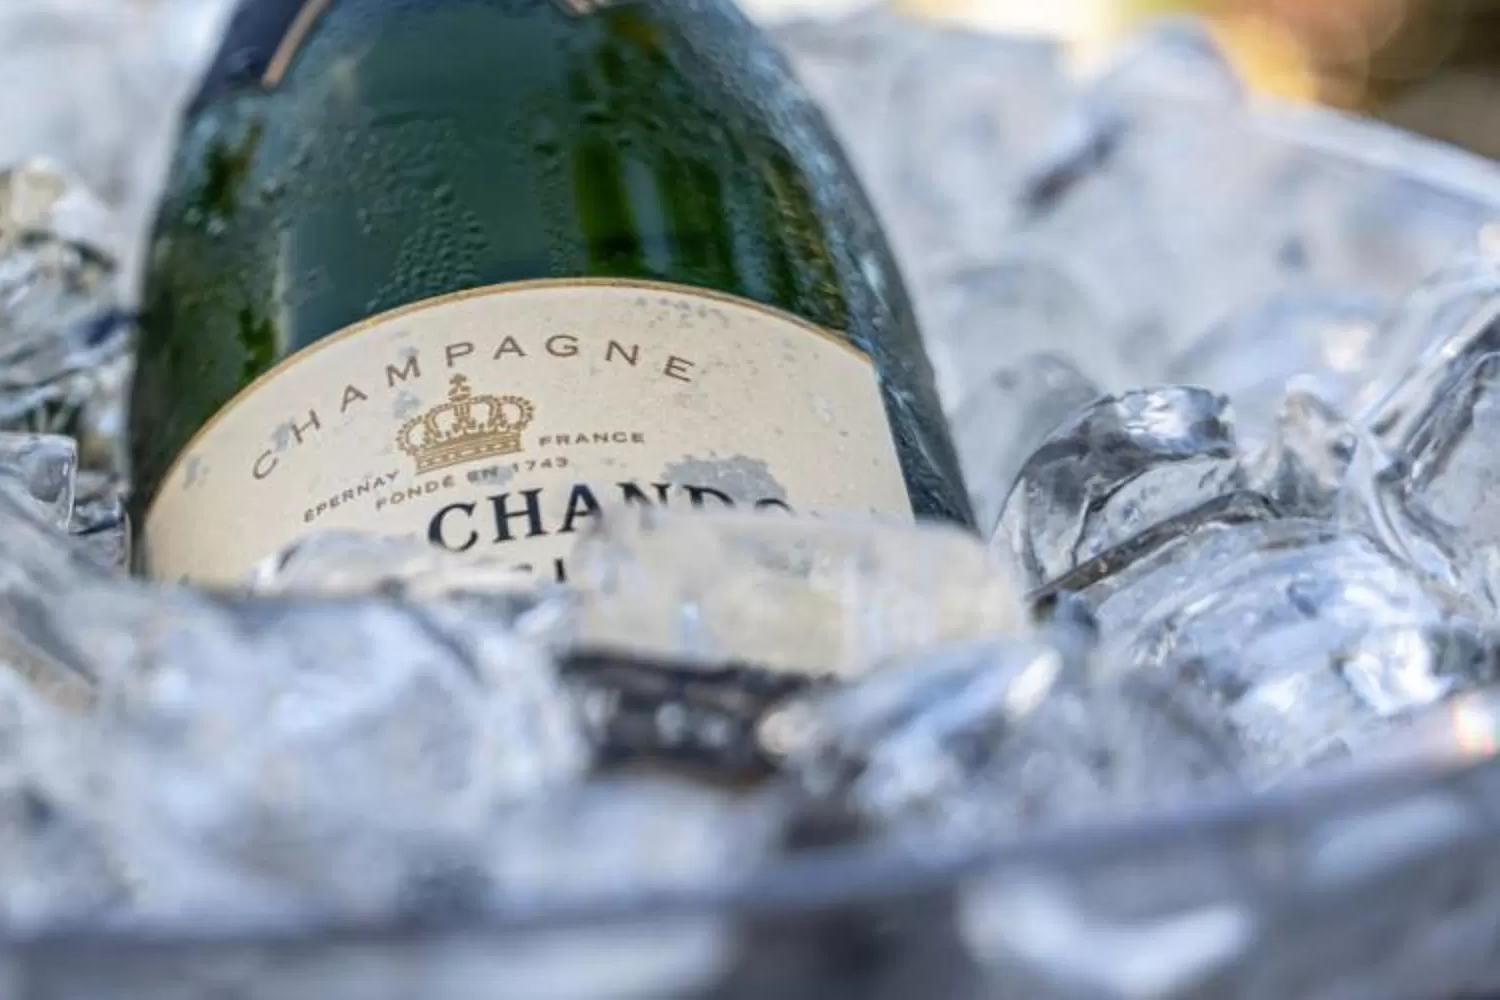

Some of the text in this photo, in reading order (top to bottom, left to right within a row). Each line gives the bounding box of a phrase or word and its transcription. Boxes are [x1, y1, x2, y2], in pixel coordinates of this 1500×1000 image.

[252, 334, 695, 480] CHAMPAGNE
[538, 431, 645, 447] FRANCE
[466, 464, 499, 483] EN
[511, 456, 570, 473] 1743
[427, 481, 798, 553] CHAND
